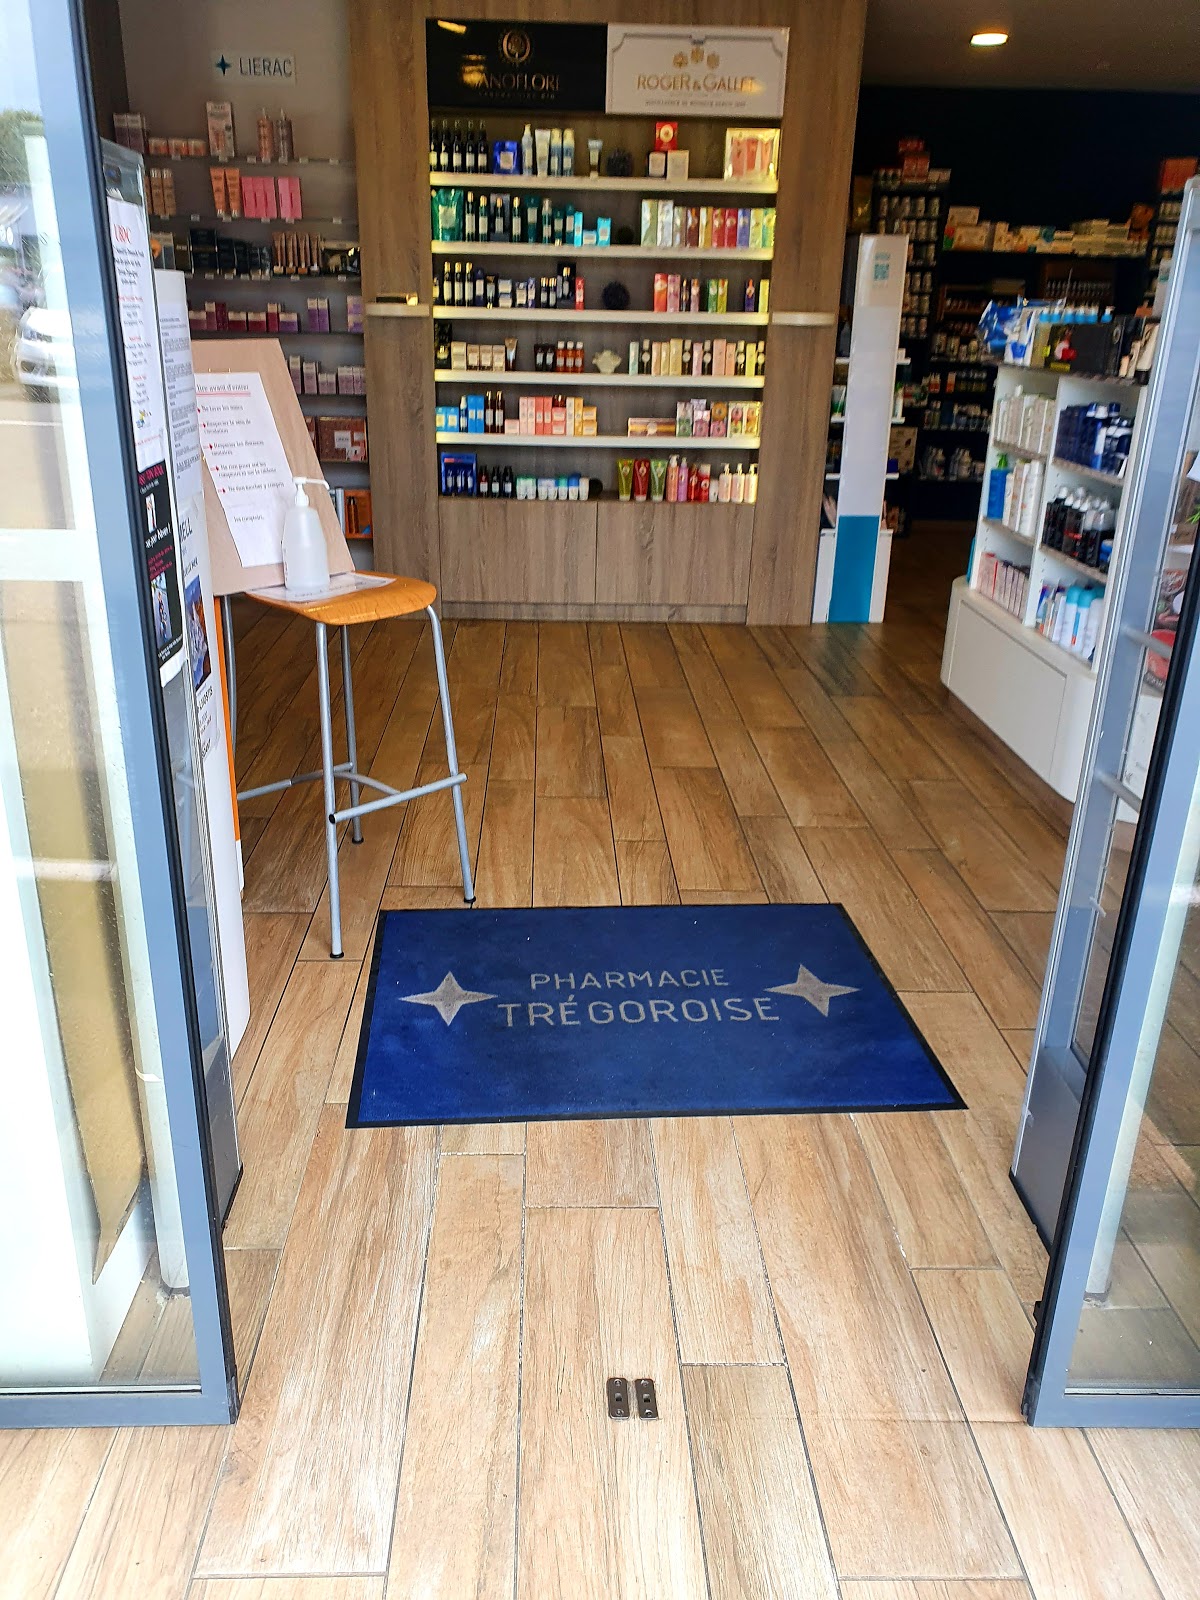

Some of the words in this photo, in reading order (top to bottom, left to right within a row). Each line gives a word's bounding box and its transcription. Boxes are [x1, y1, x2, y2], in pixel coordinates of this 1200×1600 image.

[239, 57, 293, 77] LIERAC
[637, 73, 691, 91] ROGER
[530, 969, 729, 990] PHARMACIE
[497, 994, 780, 1028] TRÉGOROISE
